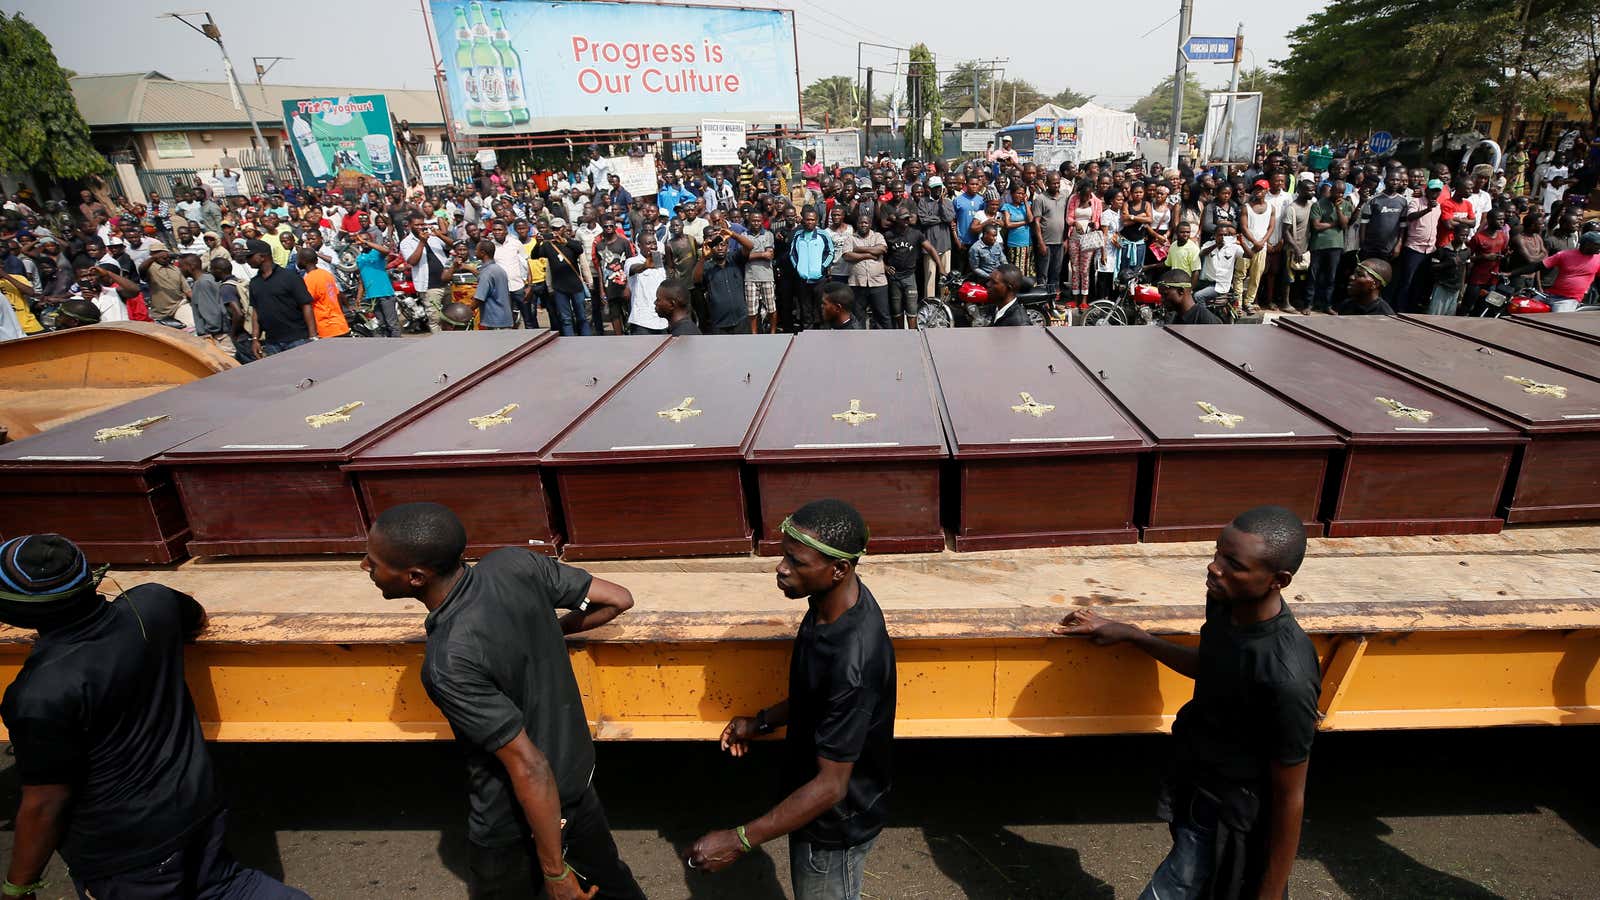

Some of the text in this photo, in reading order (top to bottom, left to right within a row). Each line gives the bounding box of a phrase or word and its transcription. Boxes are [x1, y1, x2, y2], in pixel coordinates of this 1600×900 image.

[572, 36, 723, 69] Progress is
[577, 68, 740, 93] Our Culture
[333, 101, 373, 115] yoghurt
[423, 163, 448, 172] AGAPE
